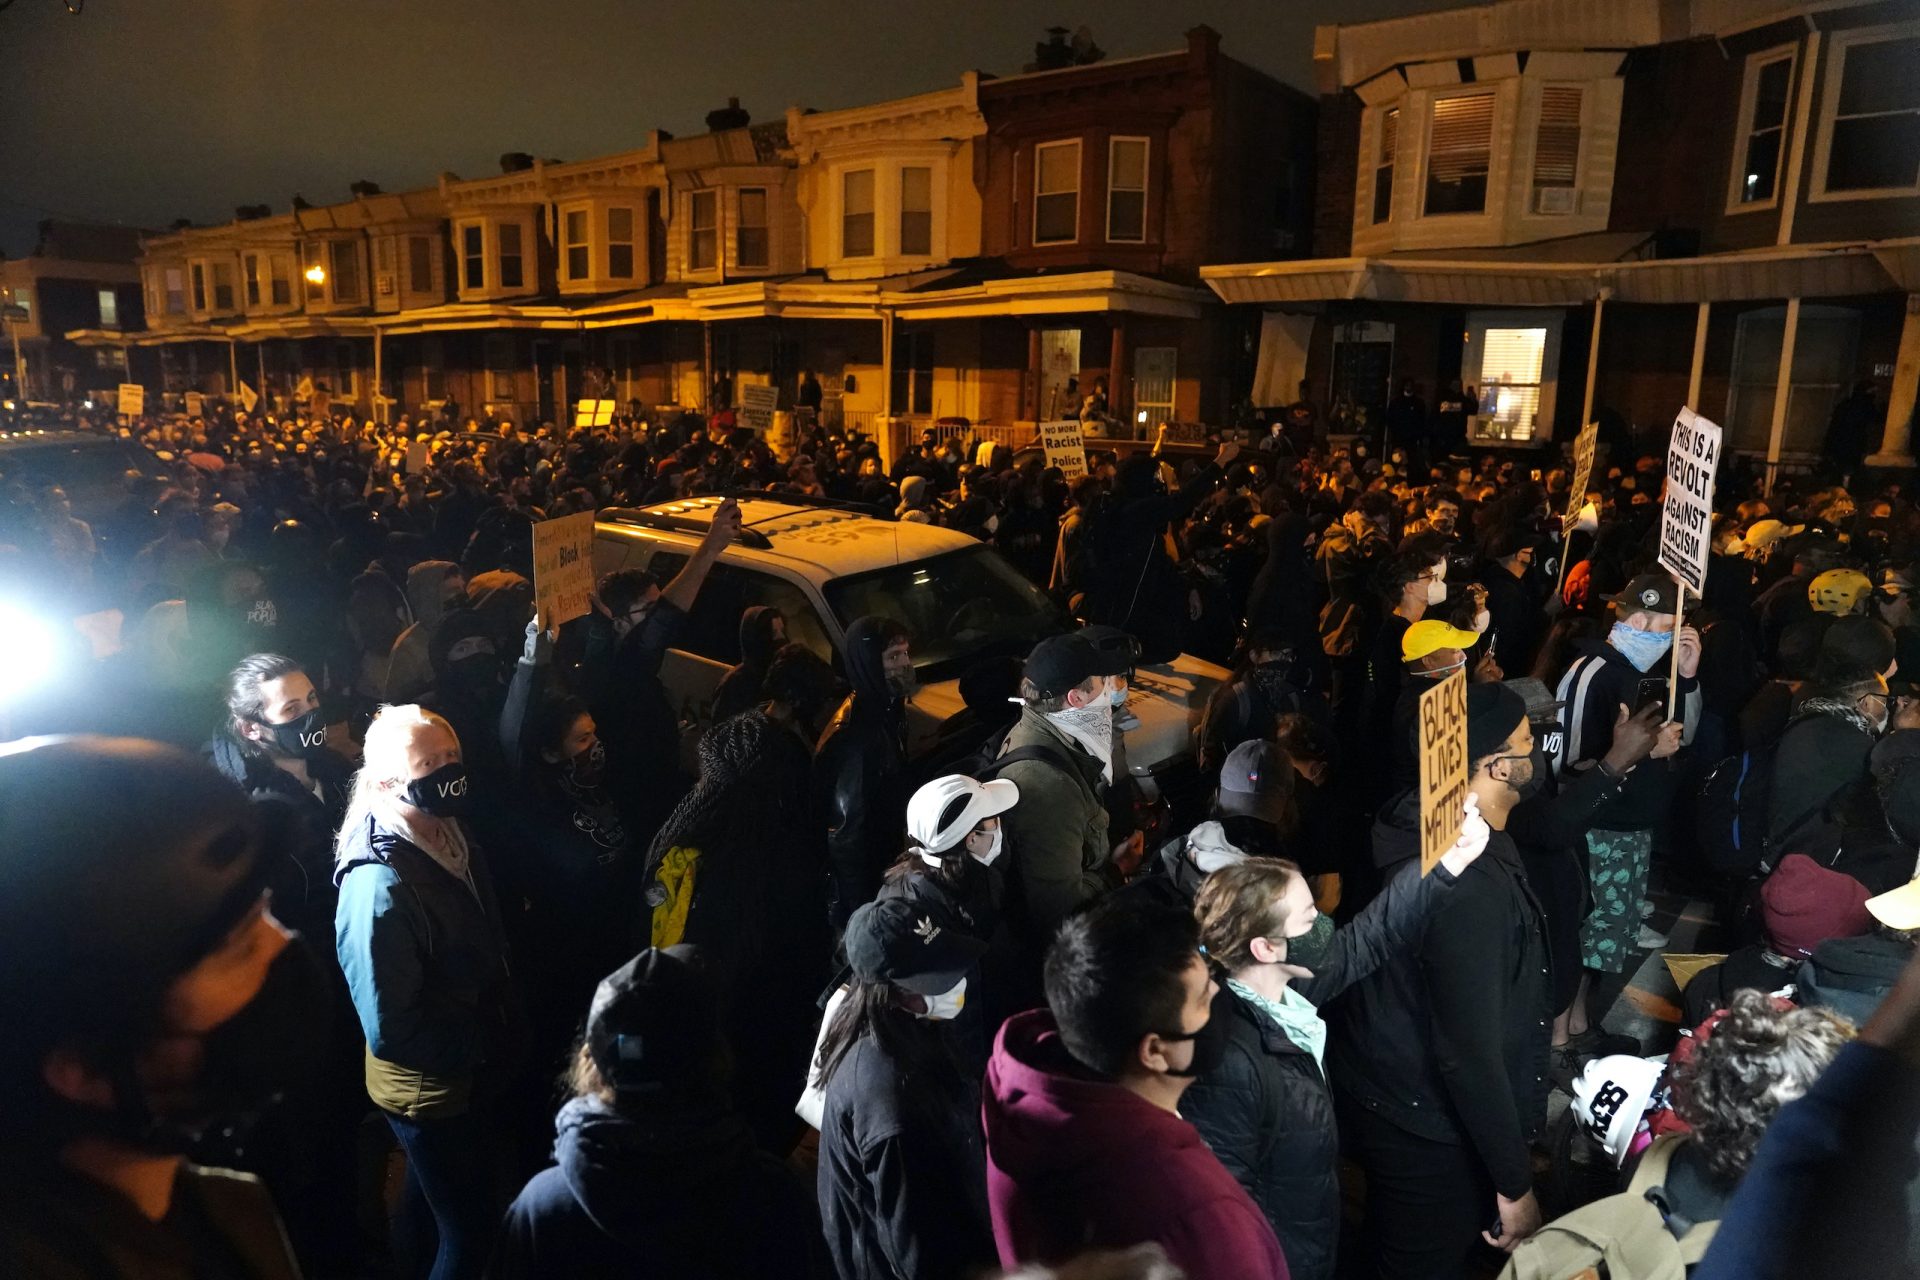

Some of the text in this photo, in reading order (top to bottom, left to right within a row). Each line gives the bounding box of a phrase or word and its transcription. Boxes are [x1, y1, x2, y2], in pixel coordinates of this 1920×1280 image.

[1045, 436, 1081, 449] Racist
[1057, 425, 1077, 434] MORE
[1673, 420, 1714, 465] THIS IS A
[1052, 455, 1082, 467] Police
[1668, 450, 1710, 501] REVOLT
[1665, 494, 1707, 535] AGAINST
[560, 541, 579, 568] Black
[1665, 519, 1701, 562] RACISM
[1422, 674, 1467, 750] BLACK
[299, 723, 328, 748] VOT
[1428, 727, 1463, 795] LIVES
[437, 775, 468, 799] VOT
[1424, 778, 1467, 860] MATTER
